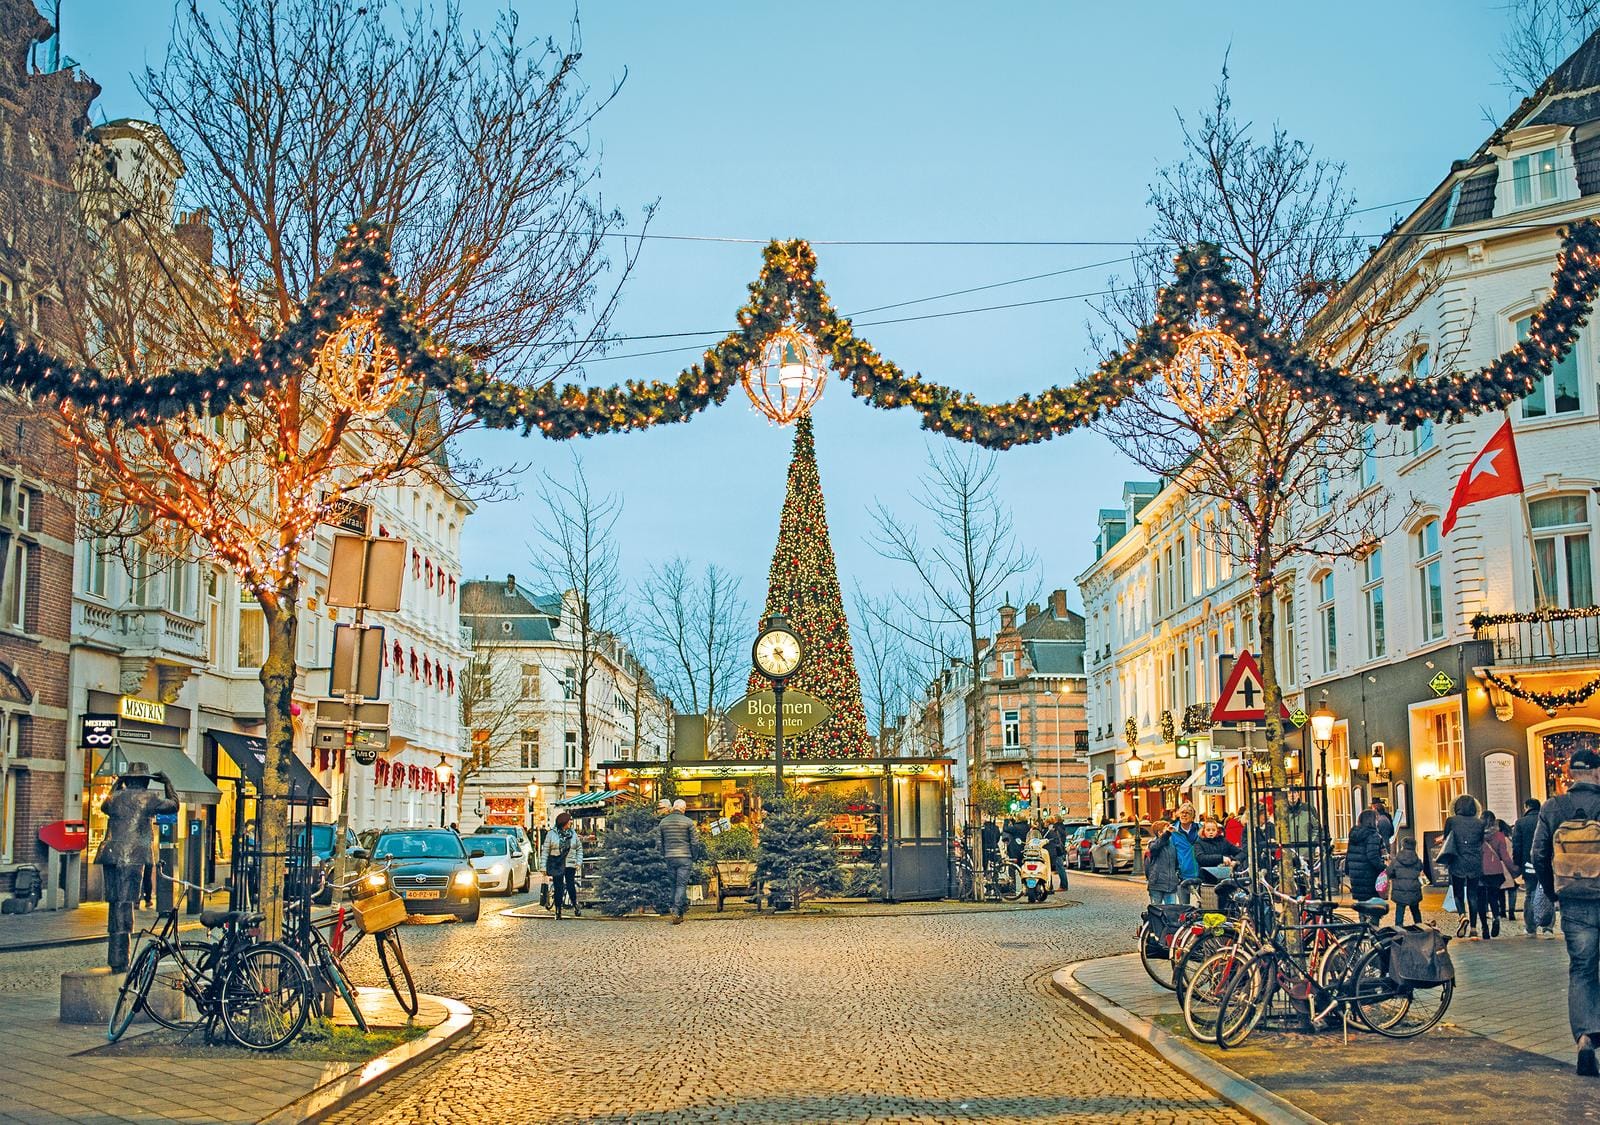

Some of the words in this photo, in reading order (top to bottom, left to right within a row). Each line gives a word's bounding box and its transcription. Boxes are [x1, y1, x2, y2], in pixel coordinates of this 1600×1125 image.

[757, 716, 765, 727] &
[768, 716, 803, 729] plnten
[1210, 763, 1219, 776] P
[162, 824, 169, 834] P
[191, 824, 199, 835] P
